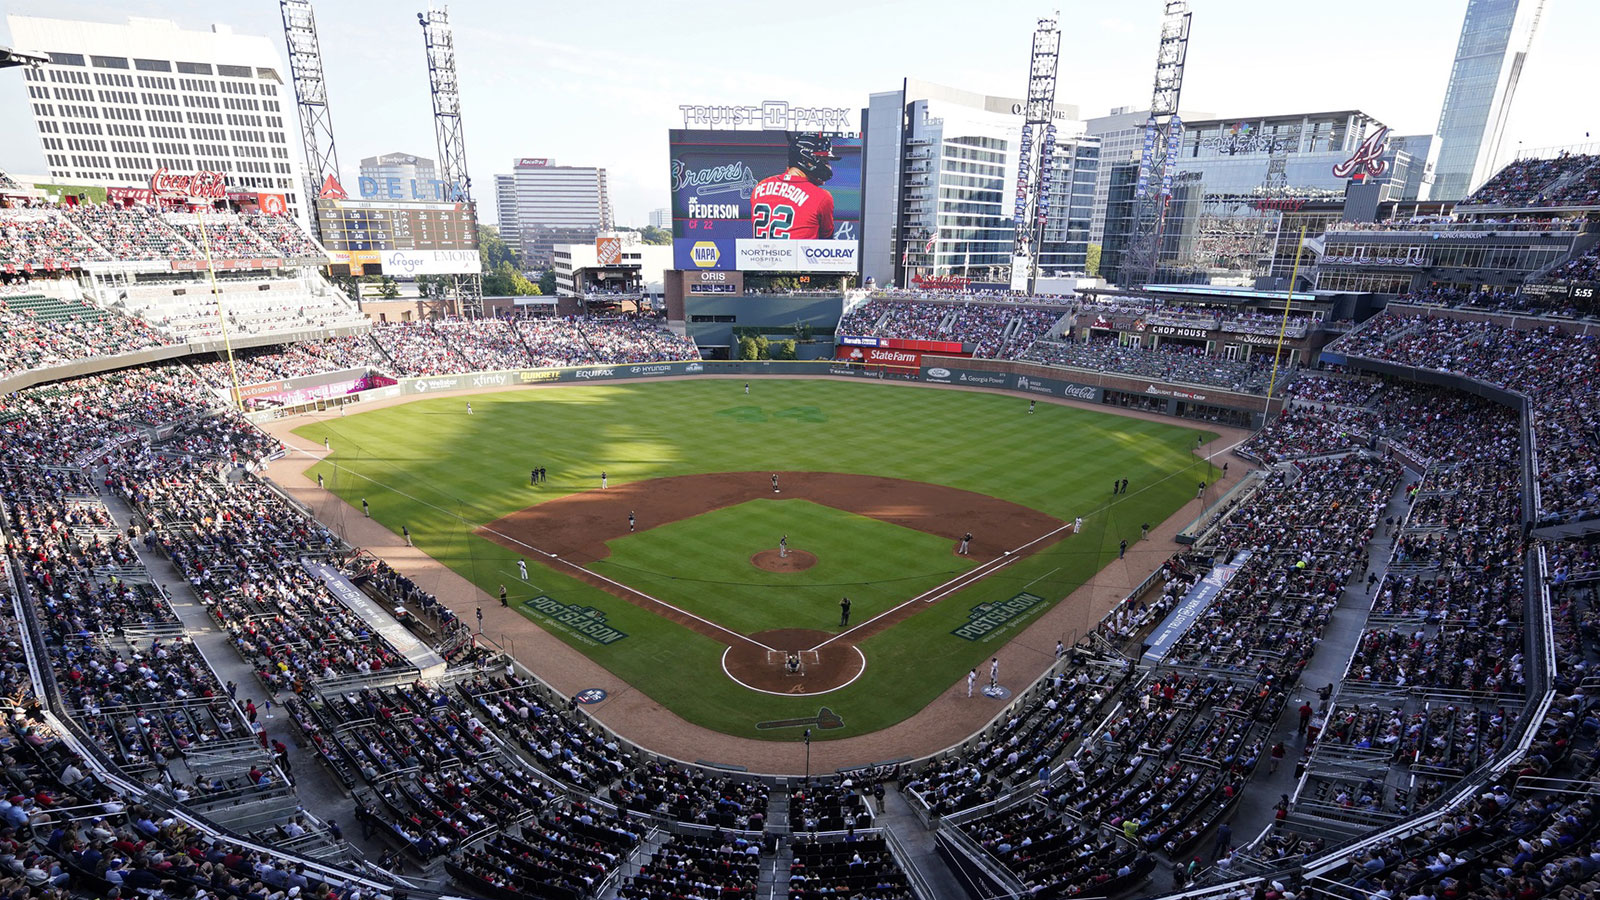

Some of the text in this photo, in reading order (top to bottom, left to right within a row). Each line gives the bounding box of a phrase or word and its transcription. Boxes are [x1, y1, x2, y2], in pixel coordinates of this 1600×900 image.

[679, 105, 851, 127] TRUIST PARK
[1203, 134, 1275, 149] COMCAST
[671, 159, 742, 192] Braves
[357, 176, 467, 201] DELTA
[754, 181, 810, 207] PEDERSON
[688, 204, 739, 219] PEDERSON
[1255, 196, 1306, 213] xfinity
[688, 221, 713, 230] CF 22
[753, 204, 795, 240] 22
[433, 250, 478, 262] EMORY
[597, 238, 620, 264] HOME
[695, 248, 716, 261] NAPA
[741, 249, 792, 257] NORTHSIDE
[805, 248, 855, 258] COOLRAY
[389, 252, 424, 272] Kroger
[701, 272, 726, 281] ORIS
[1574, 288, 1594, 298] 5:55
[1152, 325, 1207, 338] CHOP HOUSE
[1244, 334, 1272, 345] Silver
[473, 374, 506, 388] xfinity
[521, 371, 561, 380] QUIKRETE
[576, 369, 613, 379] EQUIFAX
[968, 375, 988, 384] Georgia
[527, 596, 623, 643] POSTSEASON
[955, 593, 1041, 640] POSTSEASON
